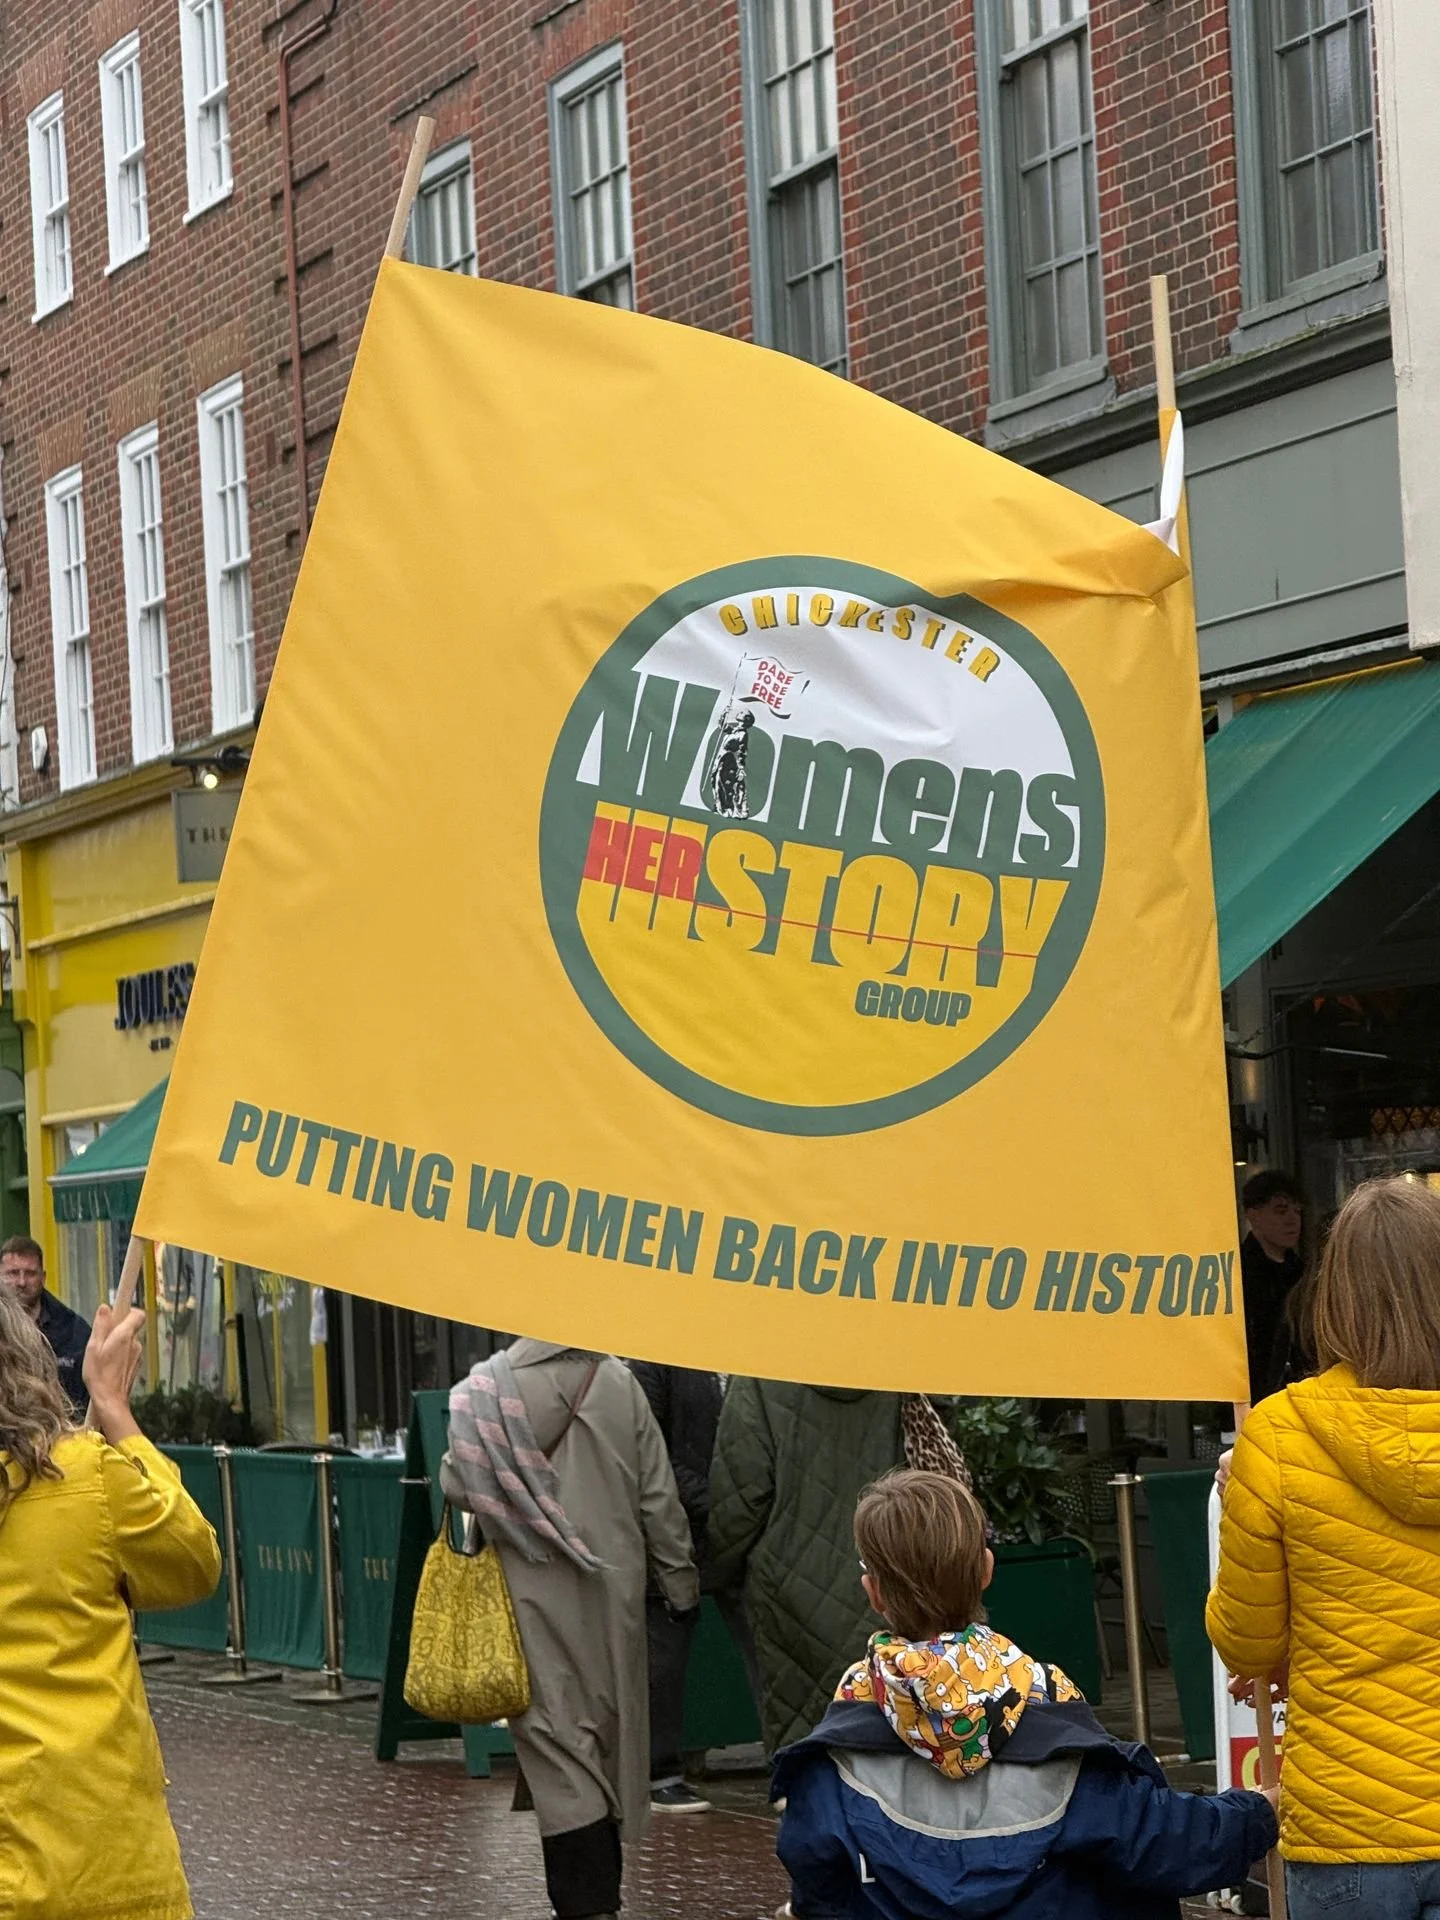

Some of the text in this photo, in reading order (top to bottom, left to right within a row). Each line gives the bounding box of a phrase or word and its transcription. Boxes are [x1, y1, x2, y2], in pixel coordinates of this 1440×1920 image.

[719, 592, 1001, 683] CHICHESTER
[751, 682, 783, 710] FREE
[757, 672, 788, 696] TO BE
[758, 660, 794, 685] DARE
[590, 668, 1080, 870] Womens
[855, 980, 971, 1027] GROUP
[218, 1101, 1235, 1317] PUTTING WOMEN BACK INTO HISTORY
